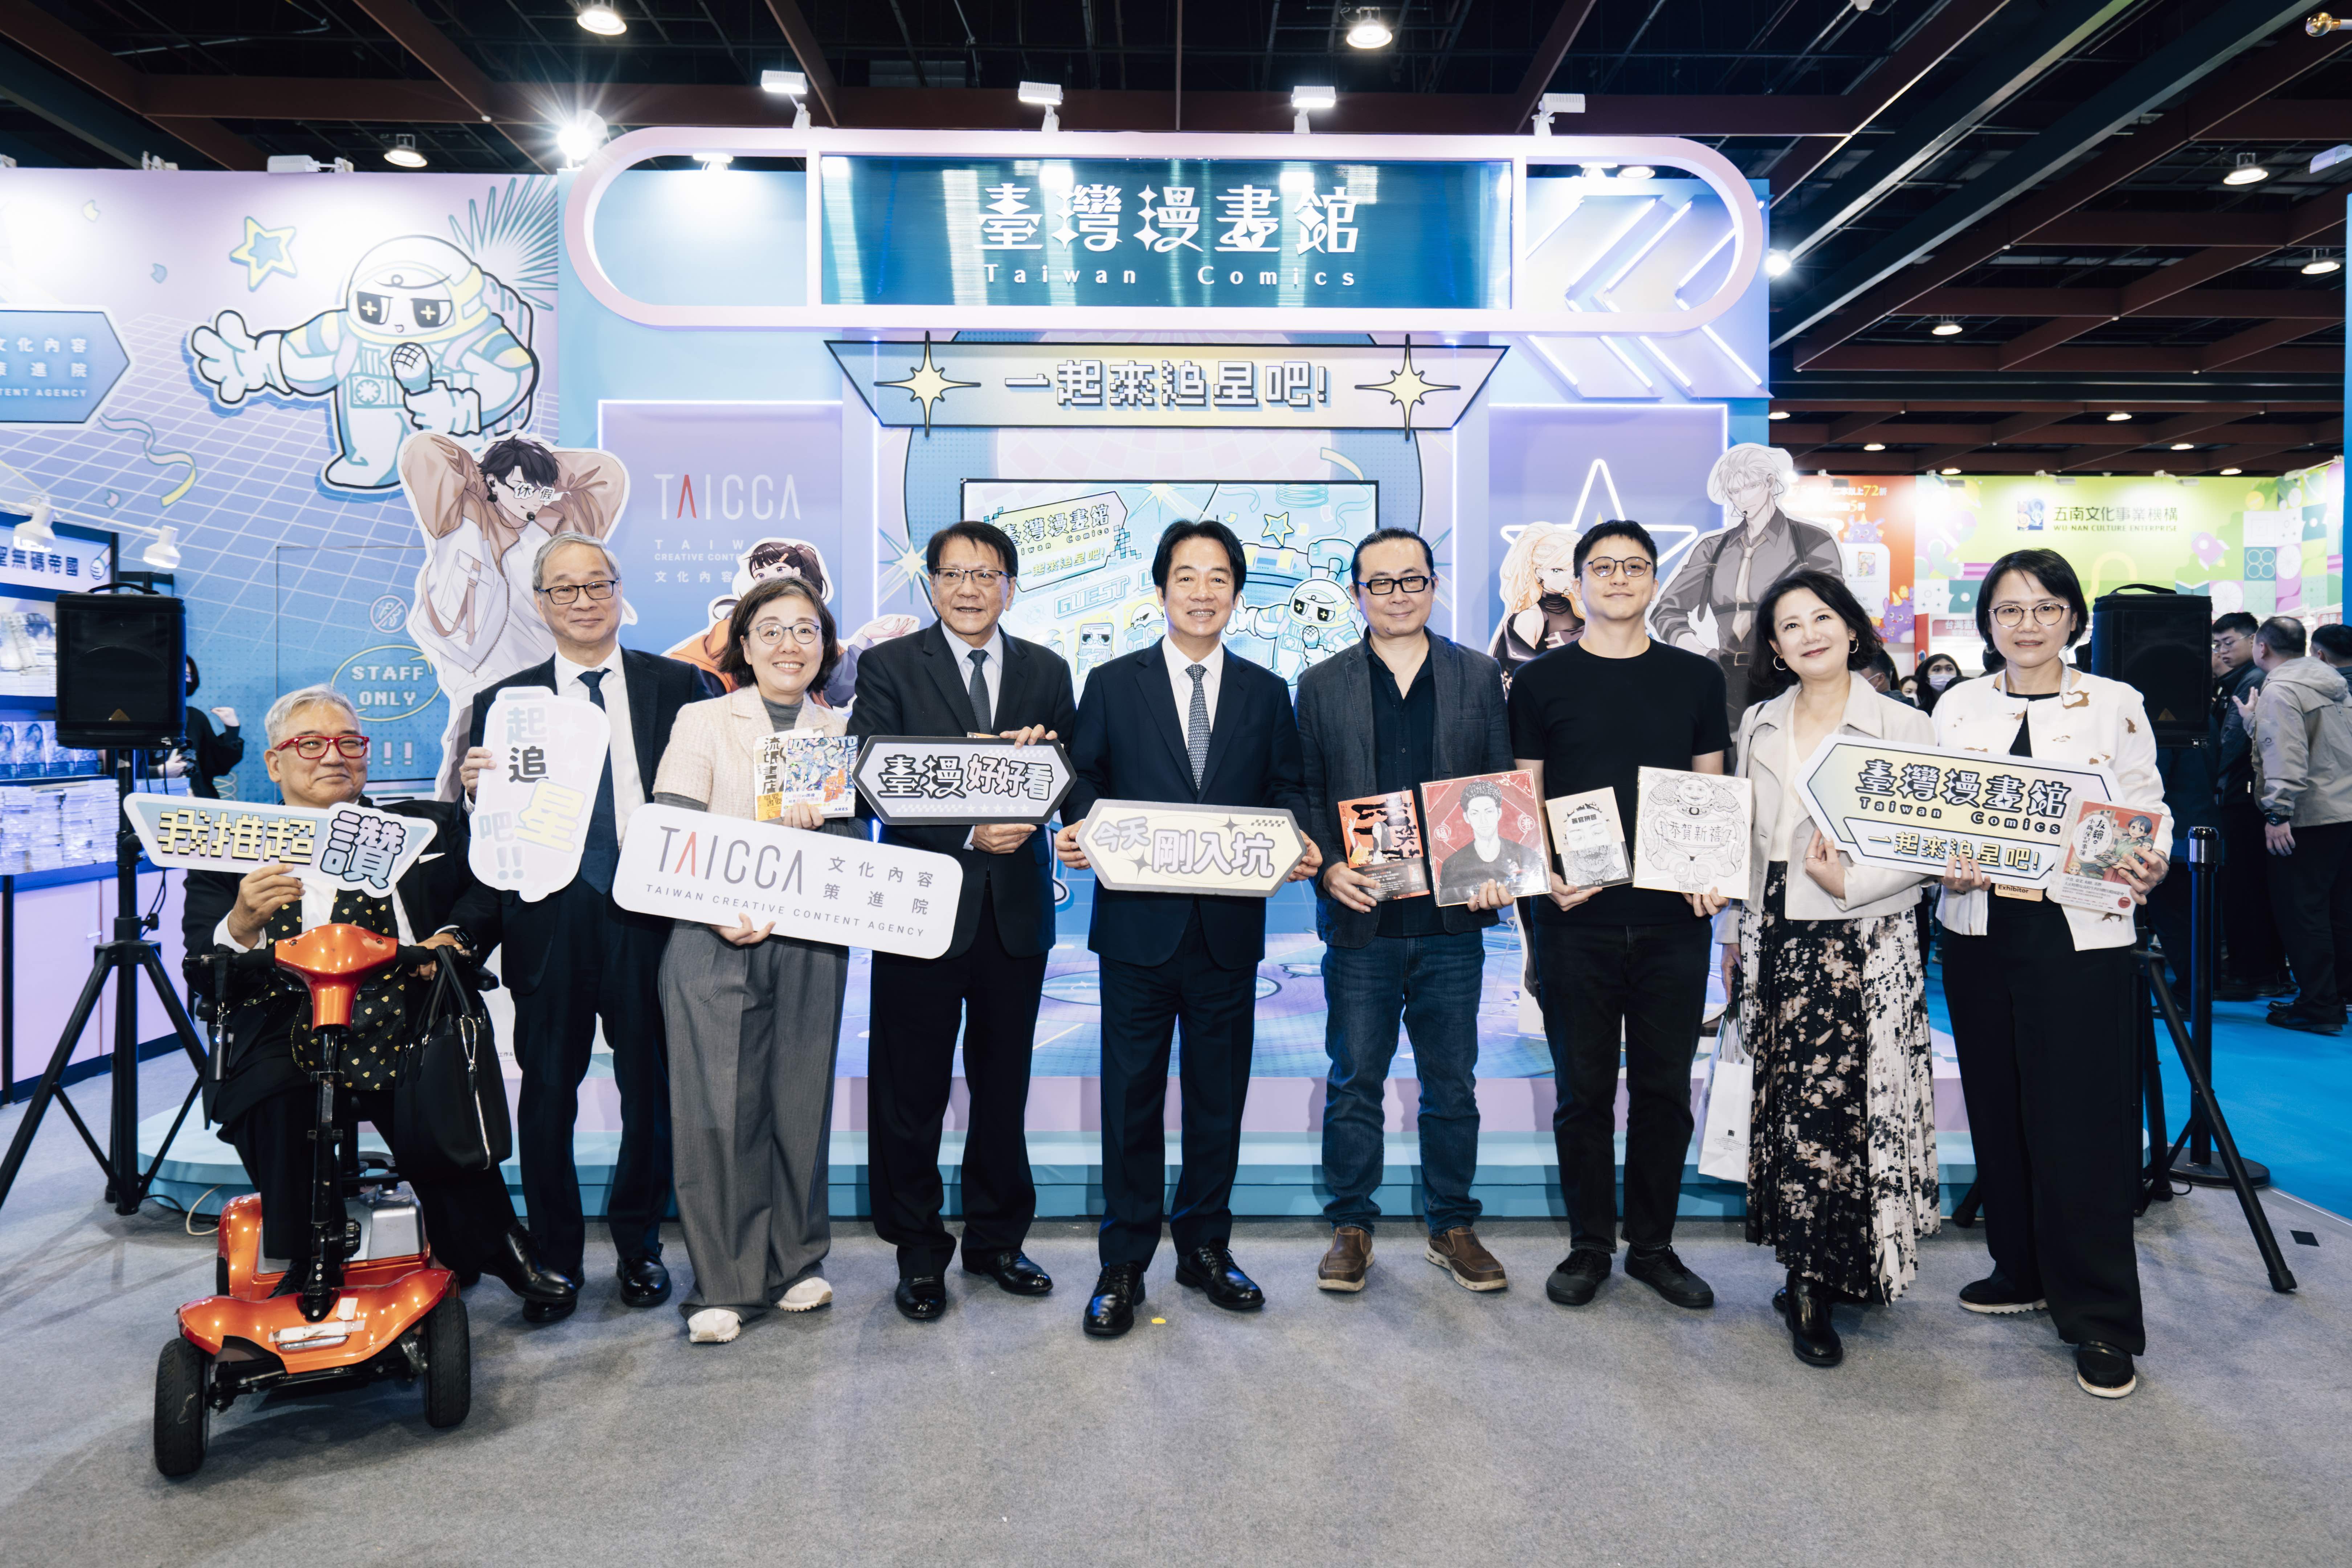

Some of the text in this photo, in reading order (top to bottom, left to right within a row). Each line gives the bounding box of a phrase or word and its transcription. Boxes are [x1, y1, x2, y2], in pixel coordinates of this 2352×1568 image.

[975, 183, 1360, 254] 臺灣漫畫館
[983, 263, 1356, 286] Taiwan Comics
[36, 388, 87, 397] AGENCY
[654, 474, 801, 520] TAICCA
[2053, 507, 2178, 522] 五南文化事業機構
[654, 539, 744, 550] TAIW
[1021, 528, 1109, 555] iwan Comics
[654, 570, 733, 583] 文化內容
[1056, 576, 1128, 616] GUEST
[352, 666, 424, 681] STAFF
[359, 691, 416, 706] ONLY
[877, 754, 1054, 801] 臺漫好好看
[1855, 759, 2071, 818] 臺灣漫畫館
[1522, 817, 1533, 829] 春
[1859, 797, 2061, 835] Taiwan Comics
[1436, 828, 1447, 839] 福
[1669, 821, 1722, 842] 恭賀新禧
[658, 826, 802, 895] TAICCA
[1091, 816, 1275, 878] 今天剛入坑
[828, 856, 933, 888] 文化內容
[823, 883, 929, 915] 策進院
[1998, 885, 2029, 893] Exhibitor
[646, 884, 924, 937] TAIWAN CREATIVE CONTENT AGENCY
